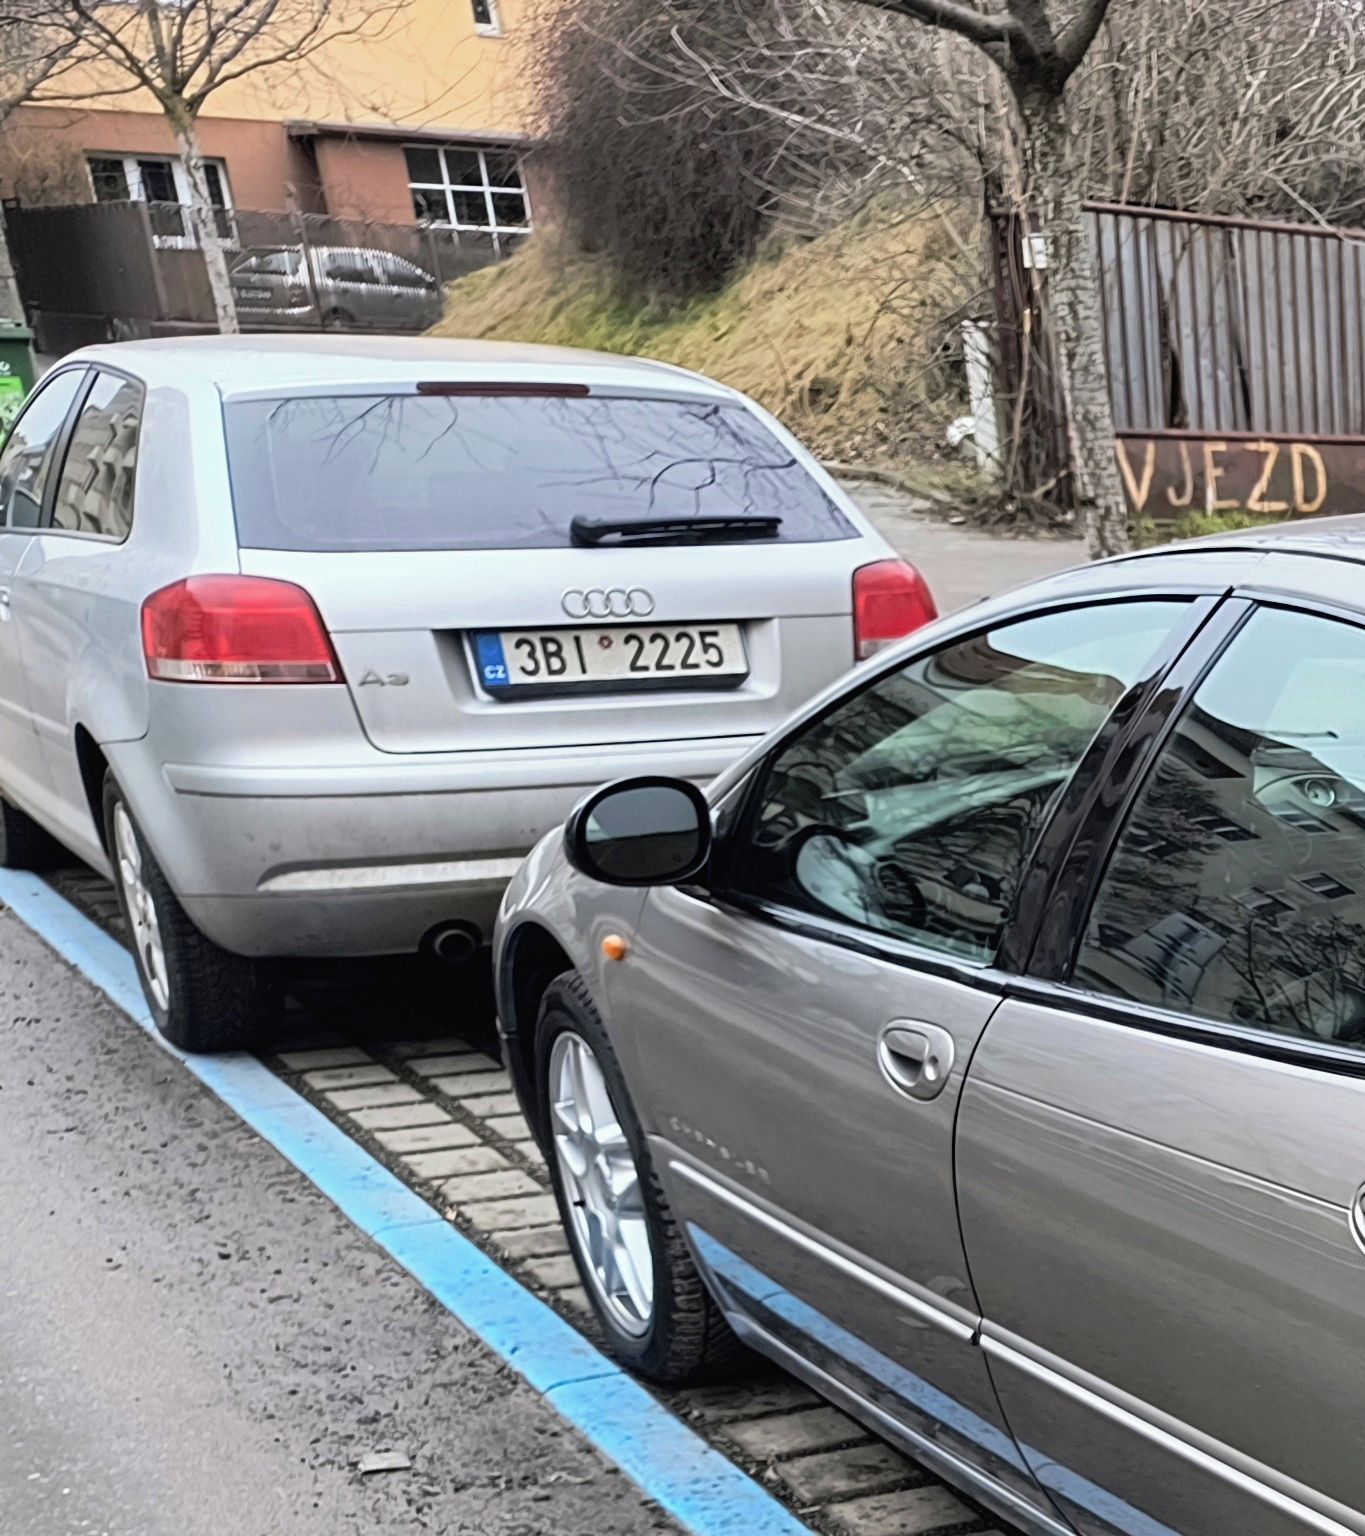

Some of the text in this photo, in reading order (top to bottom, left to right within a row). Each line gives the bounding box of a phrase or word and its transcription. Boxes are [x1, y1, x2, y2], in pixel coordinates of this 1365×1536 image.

[1116, 440, 1327, 516] VJEZD
[484, 664, 507, 680] CZ
[623, 630, 725, 672] 2225
